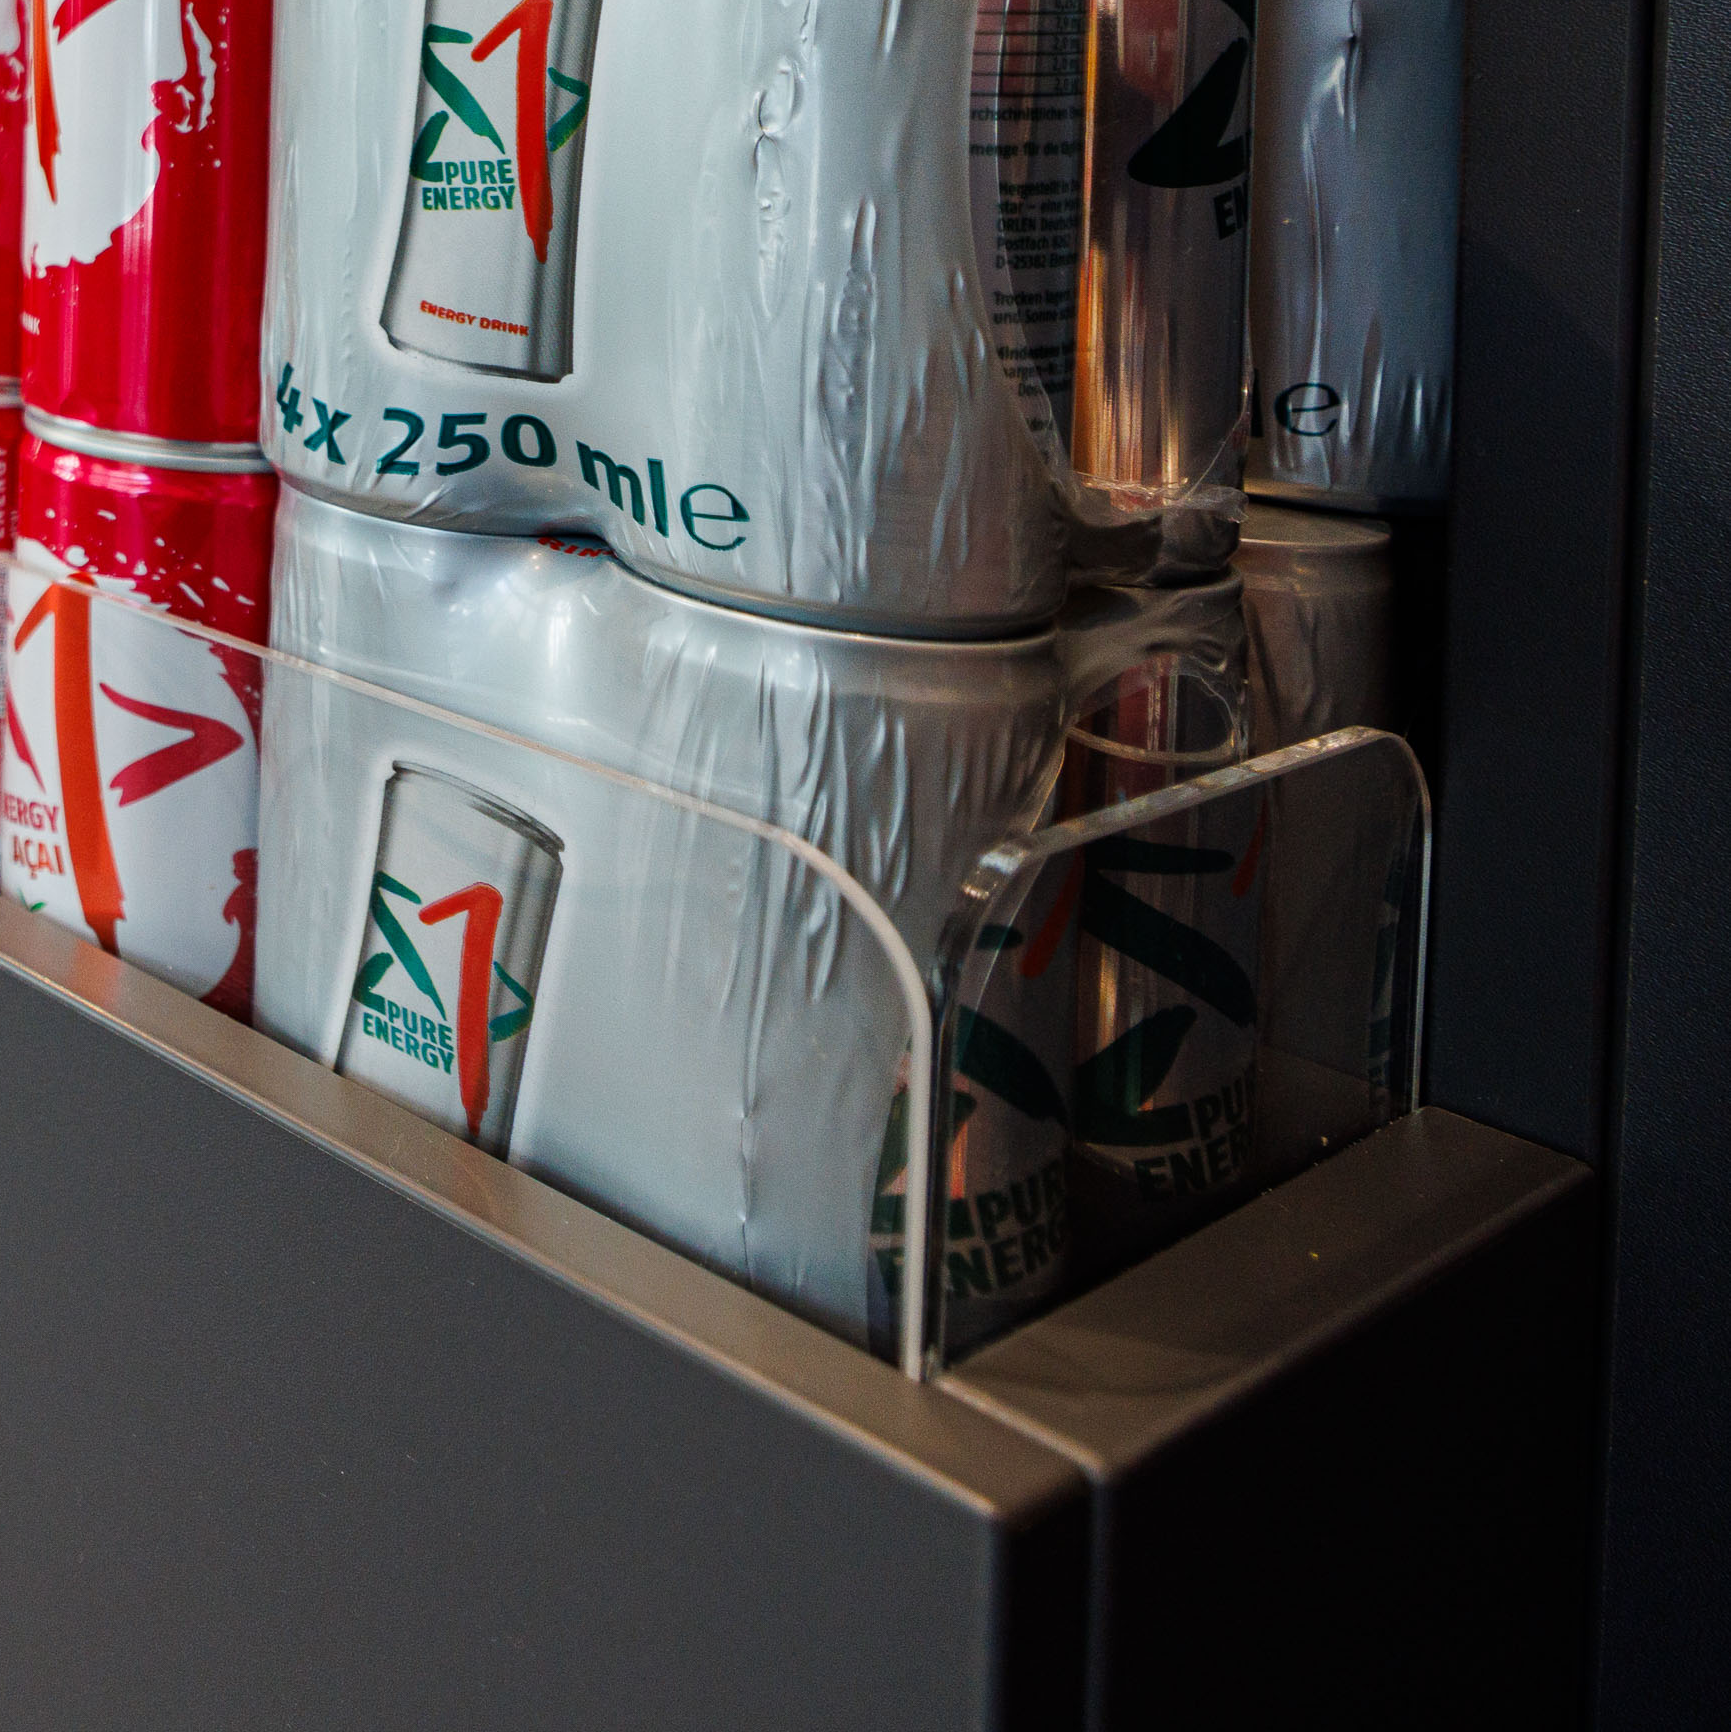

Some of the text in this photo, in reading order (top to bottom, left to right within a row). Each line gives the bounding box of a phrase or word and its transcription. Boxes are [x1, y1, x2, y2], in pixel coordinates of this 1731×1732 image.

[445, 159, 514, 185] PURE
[422, 185, 516, 211] ENERGY
[997, 219, 1036, 233] ORLEN
[420, 300, 529, 336] ENERGY DRINK
[377, 406, 558, 476] 250
[13, 835, 65, 879] AÇAI
[363, 1012, 454, 1075] ENERGY
[387, 1000, 454, 1052] PURE
